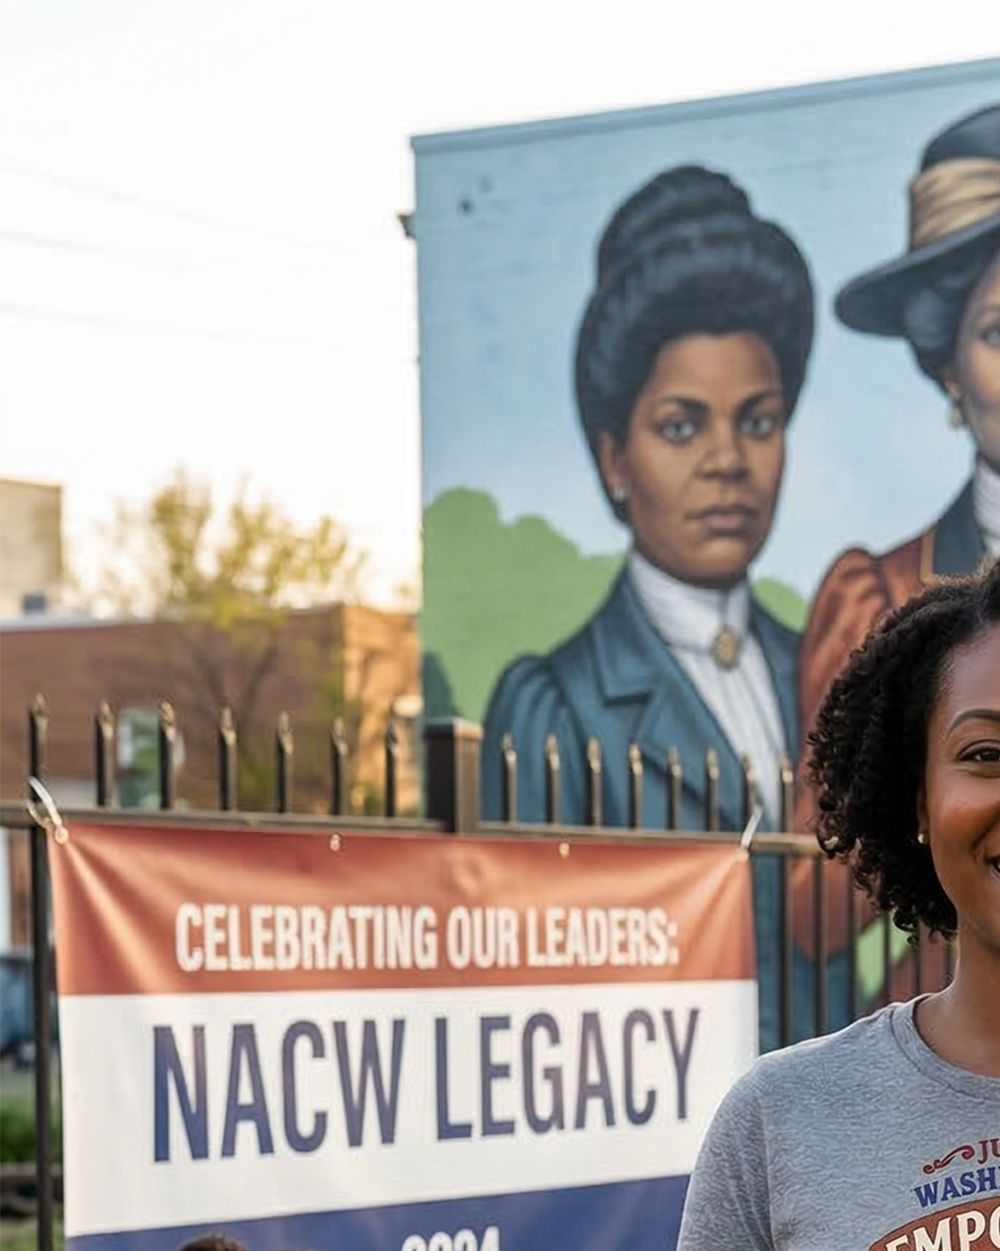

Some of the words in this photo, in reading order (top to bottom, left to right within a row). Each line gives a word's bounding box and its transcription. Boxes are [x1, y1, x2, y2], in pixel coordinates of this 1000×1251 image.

[175, 902, 436, 972] CELEBRATING
[446, 904, 520, 968] OUR
[526, 905, 680, 968] LEADERS:
[153, 1015, 407, 1164] NACW
[434, 1007, 701, 1142] LEGACY
